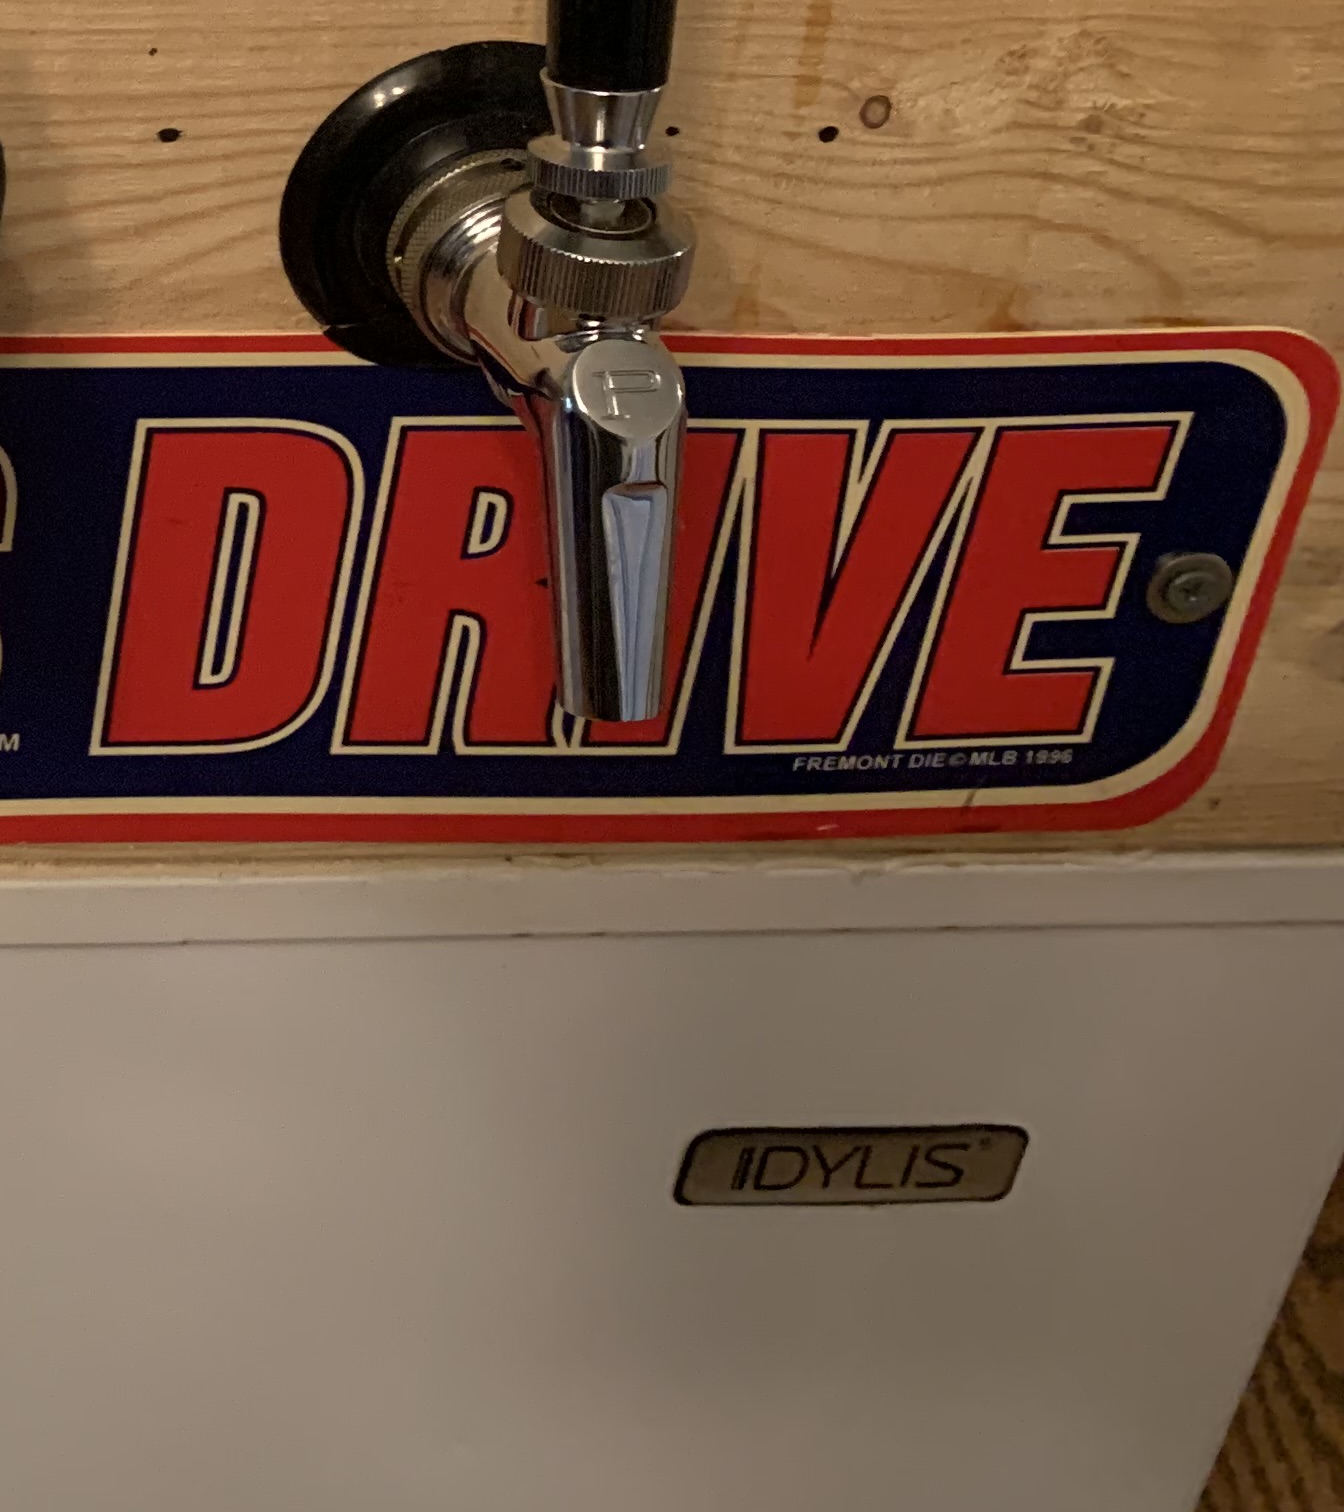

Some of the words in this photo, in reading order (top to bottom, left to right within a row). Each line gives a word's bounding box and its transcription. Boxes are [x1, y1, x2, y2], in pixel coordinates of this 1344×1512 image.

[592, 369, 662, 420] P
[792, 753, 902, 772] FREMONT
[730, 1143, 972, 1191] IDYLIS
